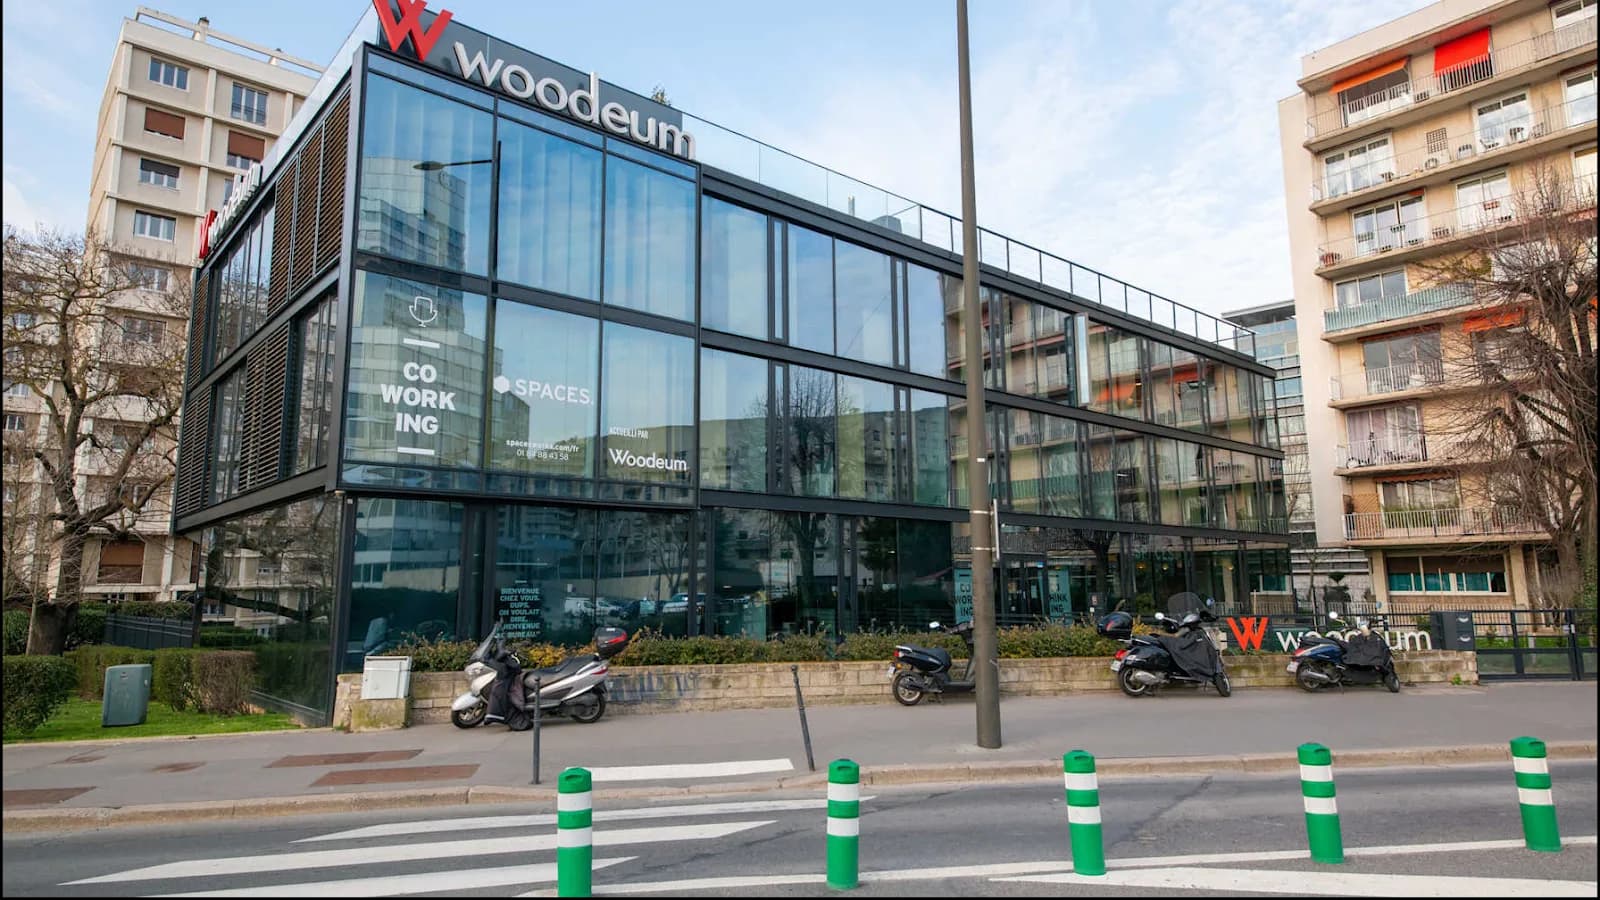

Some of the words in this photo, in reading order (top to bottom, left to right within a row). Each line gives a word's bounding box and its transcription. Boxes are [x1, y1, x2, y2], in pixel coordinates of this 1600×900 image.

[453, 41, 697, 161] woodeum
[402, 361, 438, 384] CO
[380, 383, 457, 411] WORK
[395, 412, 440, 435] ING
[608, 447, 687, 471] Woodeum
